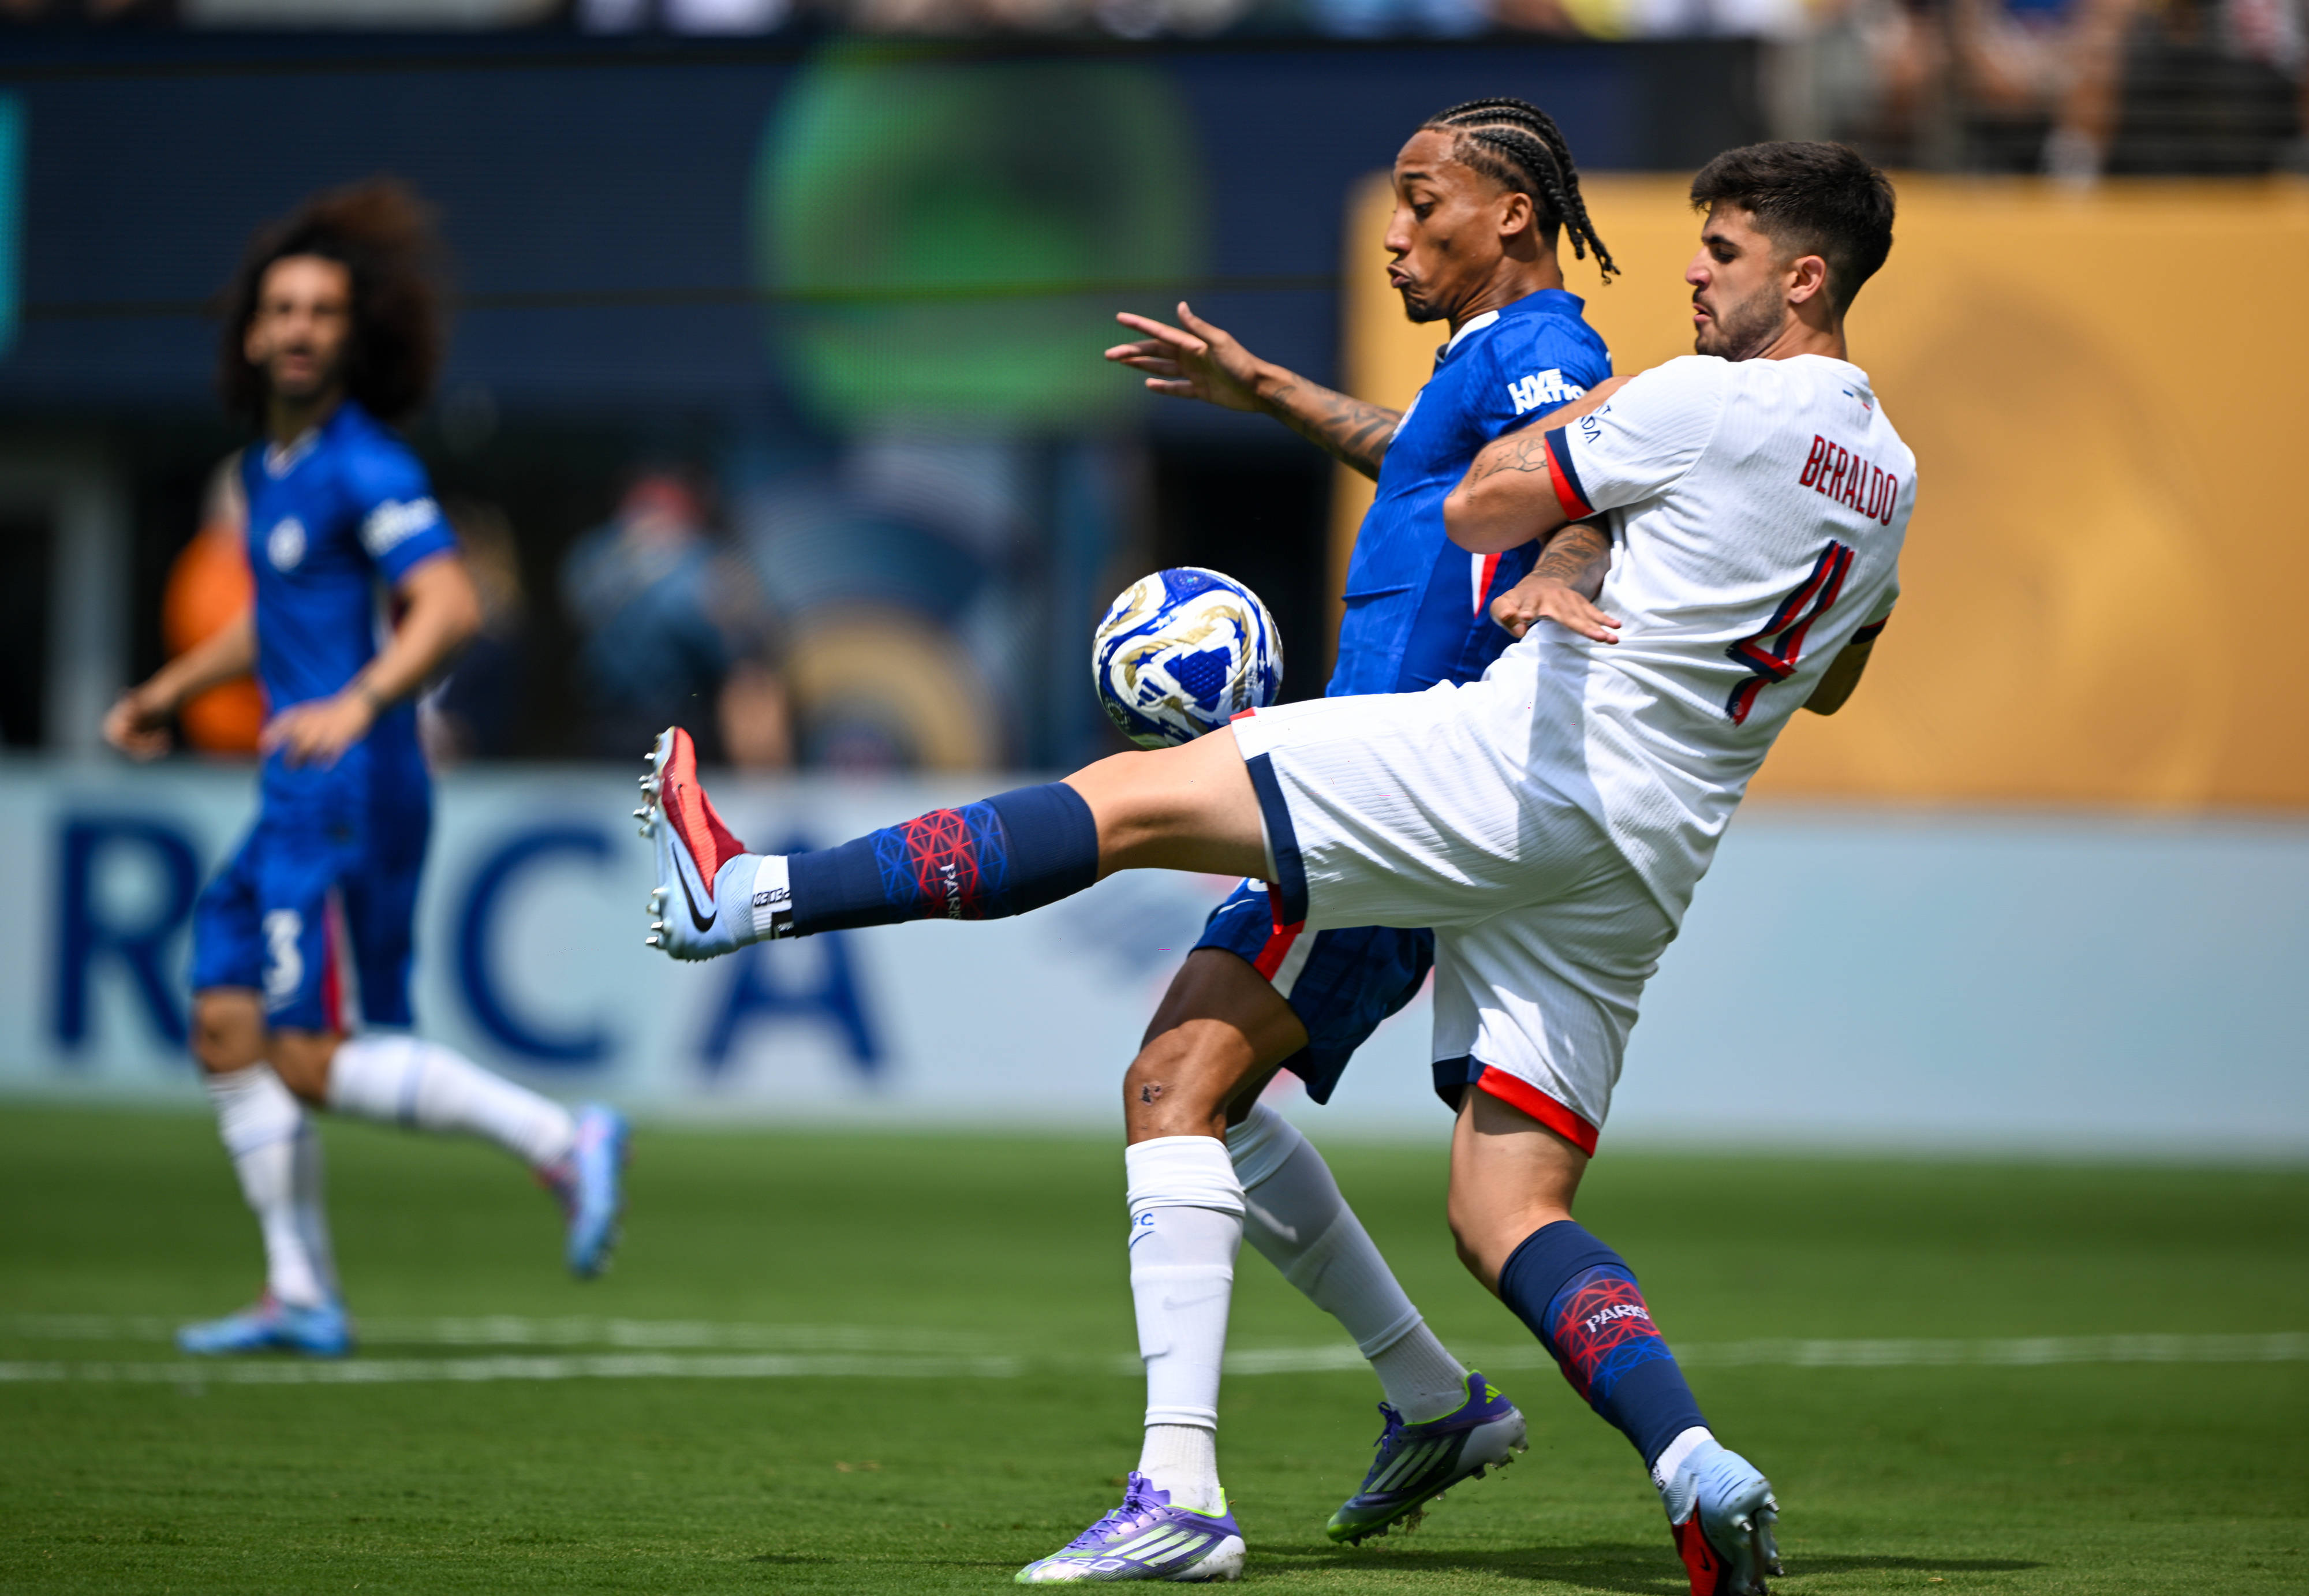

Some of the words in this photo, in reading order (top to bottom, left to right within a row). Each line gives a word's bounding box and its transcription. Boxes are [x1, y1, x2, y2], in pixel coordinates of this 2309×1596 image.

[1507, 368, 1563, 399] LIVE
[1514, 384, 1587, 415] NATIO
[1799, 434, 1898, 526] BERALDO
[1724, 539, 1855, 727] 4
[261, 908, 304, 997] 3
[1586, 1305, 1649, 1333] PARIS
